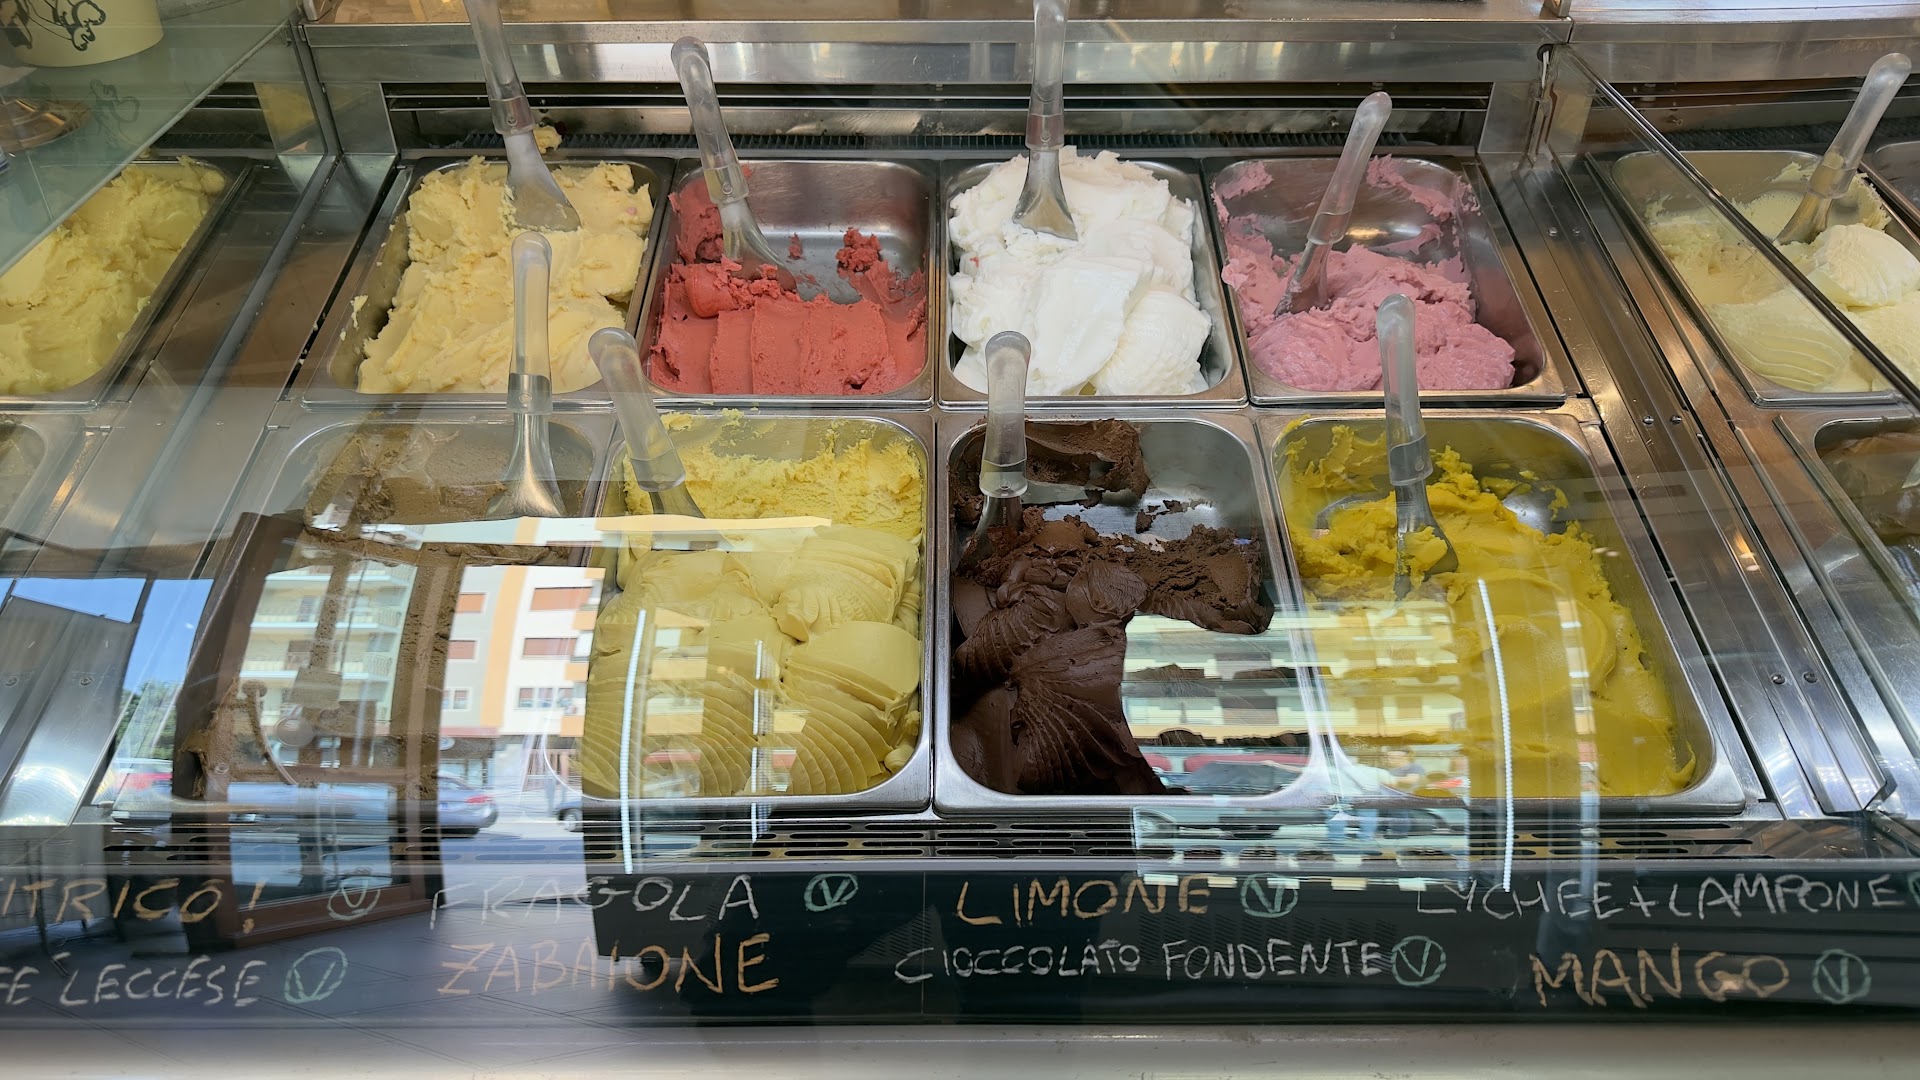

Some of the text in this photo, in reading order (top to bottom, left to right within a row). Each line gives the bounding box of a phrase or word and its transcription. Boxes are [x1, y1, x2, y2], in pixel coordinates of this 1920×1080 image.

[429, 874, 760, 930] FRAGOLA
[956, 874, 1212, 927] LIMONE
[59, 954, 268, 1007] LECCESE
[437, 933, 780, 996] ZABAIONE
[894, 938, 1141, 985] CIOCCOLATO
[1162, 938, 1384, 981] FONDENTE
[1529, 943, 1790, 1008] MANGO
